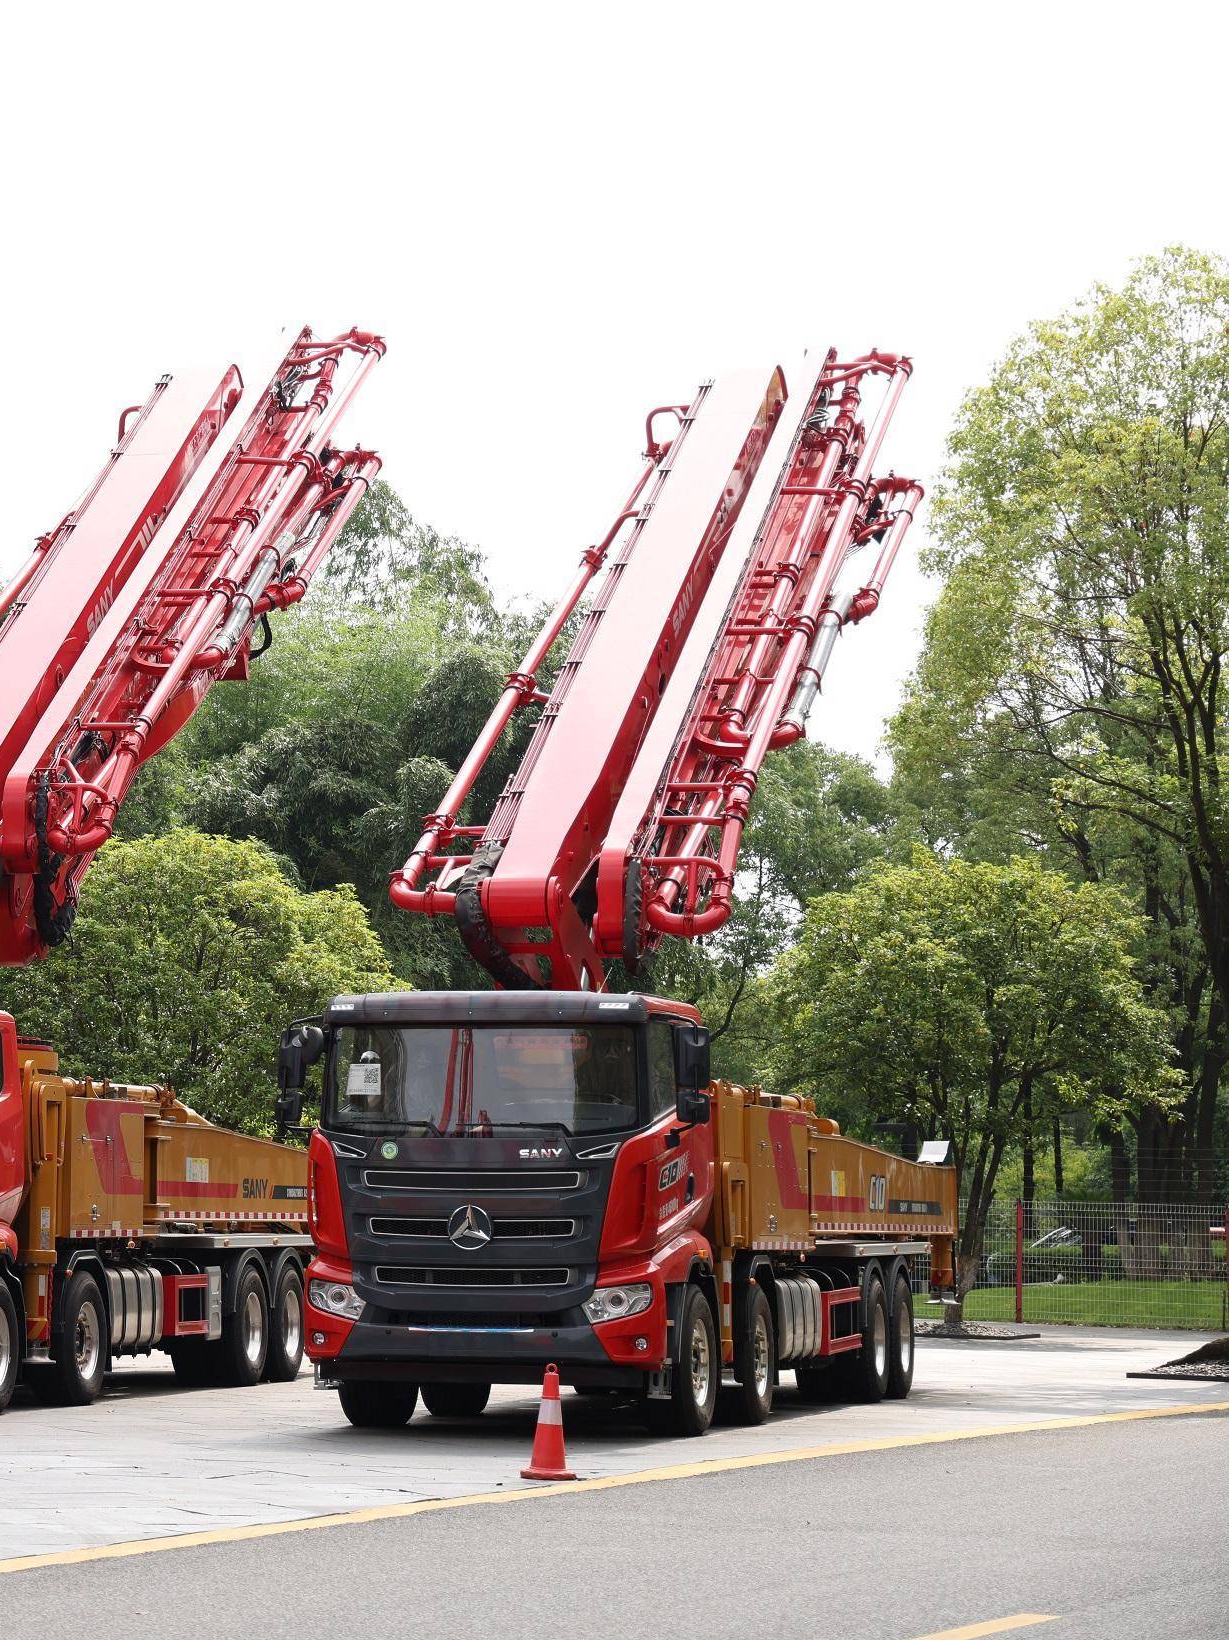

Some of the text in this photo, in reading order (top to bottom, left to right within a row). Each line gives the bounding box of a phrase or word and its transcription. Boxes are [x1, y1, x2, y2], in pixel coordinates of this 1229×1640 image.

[86, 577, 115, 640] SANY
[672, 574, 693, 640] SANY
[519, 1148, 563, 1159] SANY
[242, 1177, 269, 1199] SANY
